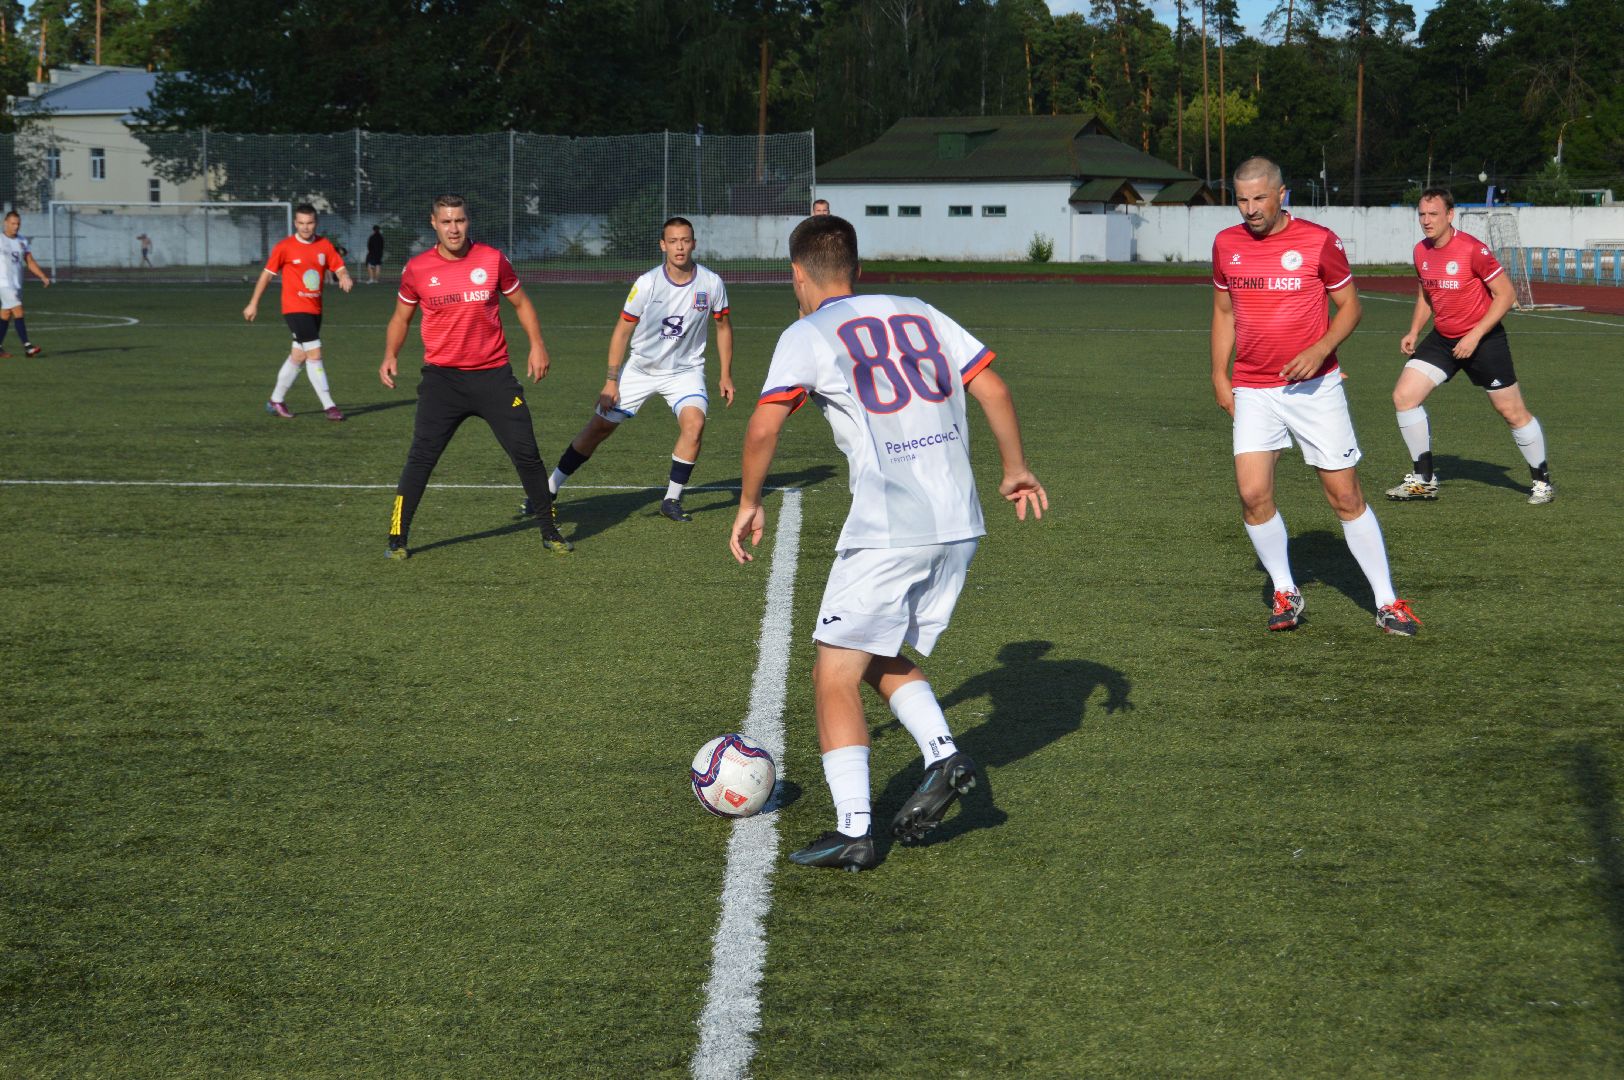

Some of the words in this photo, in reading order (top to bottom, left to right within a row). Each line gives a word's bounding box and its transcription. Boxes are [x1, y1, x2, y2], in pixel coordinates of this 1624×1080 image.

[1229, 277, 1265, 290] TECHNO
[1268, 277, 1301, 291] LASER
[428, 293, 461, 306] TECHNO
[463, 290, 490, 303] LASER
[837, 314, 953, 414] 88
